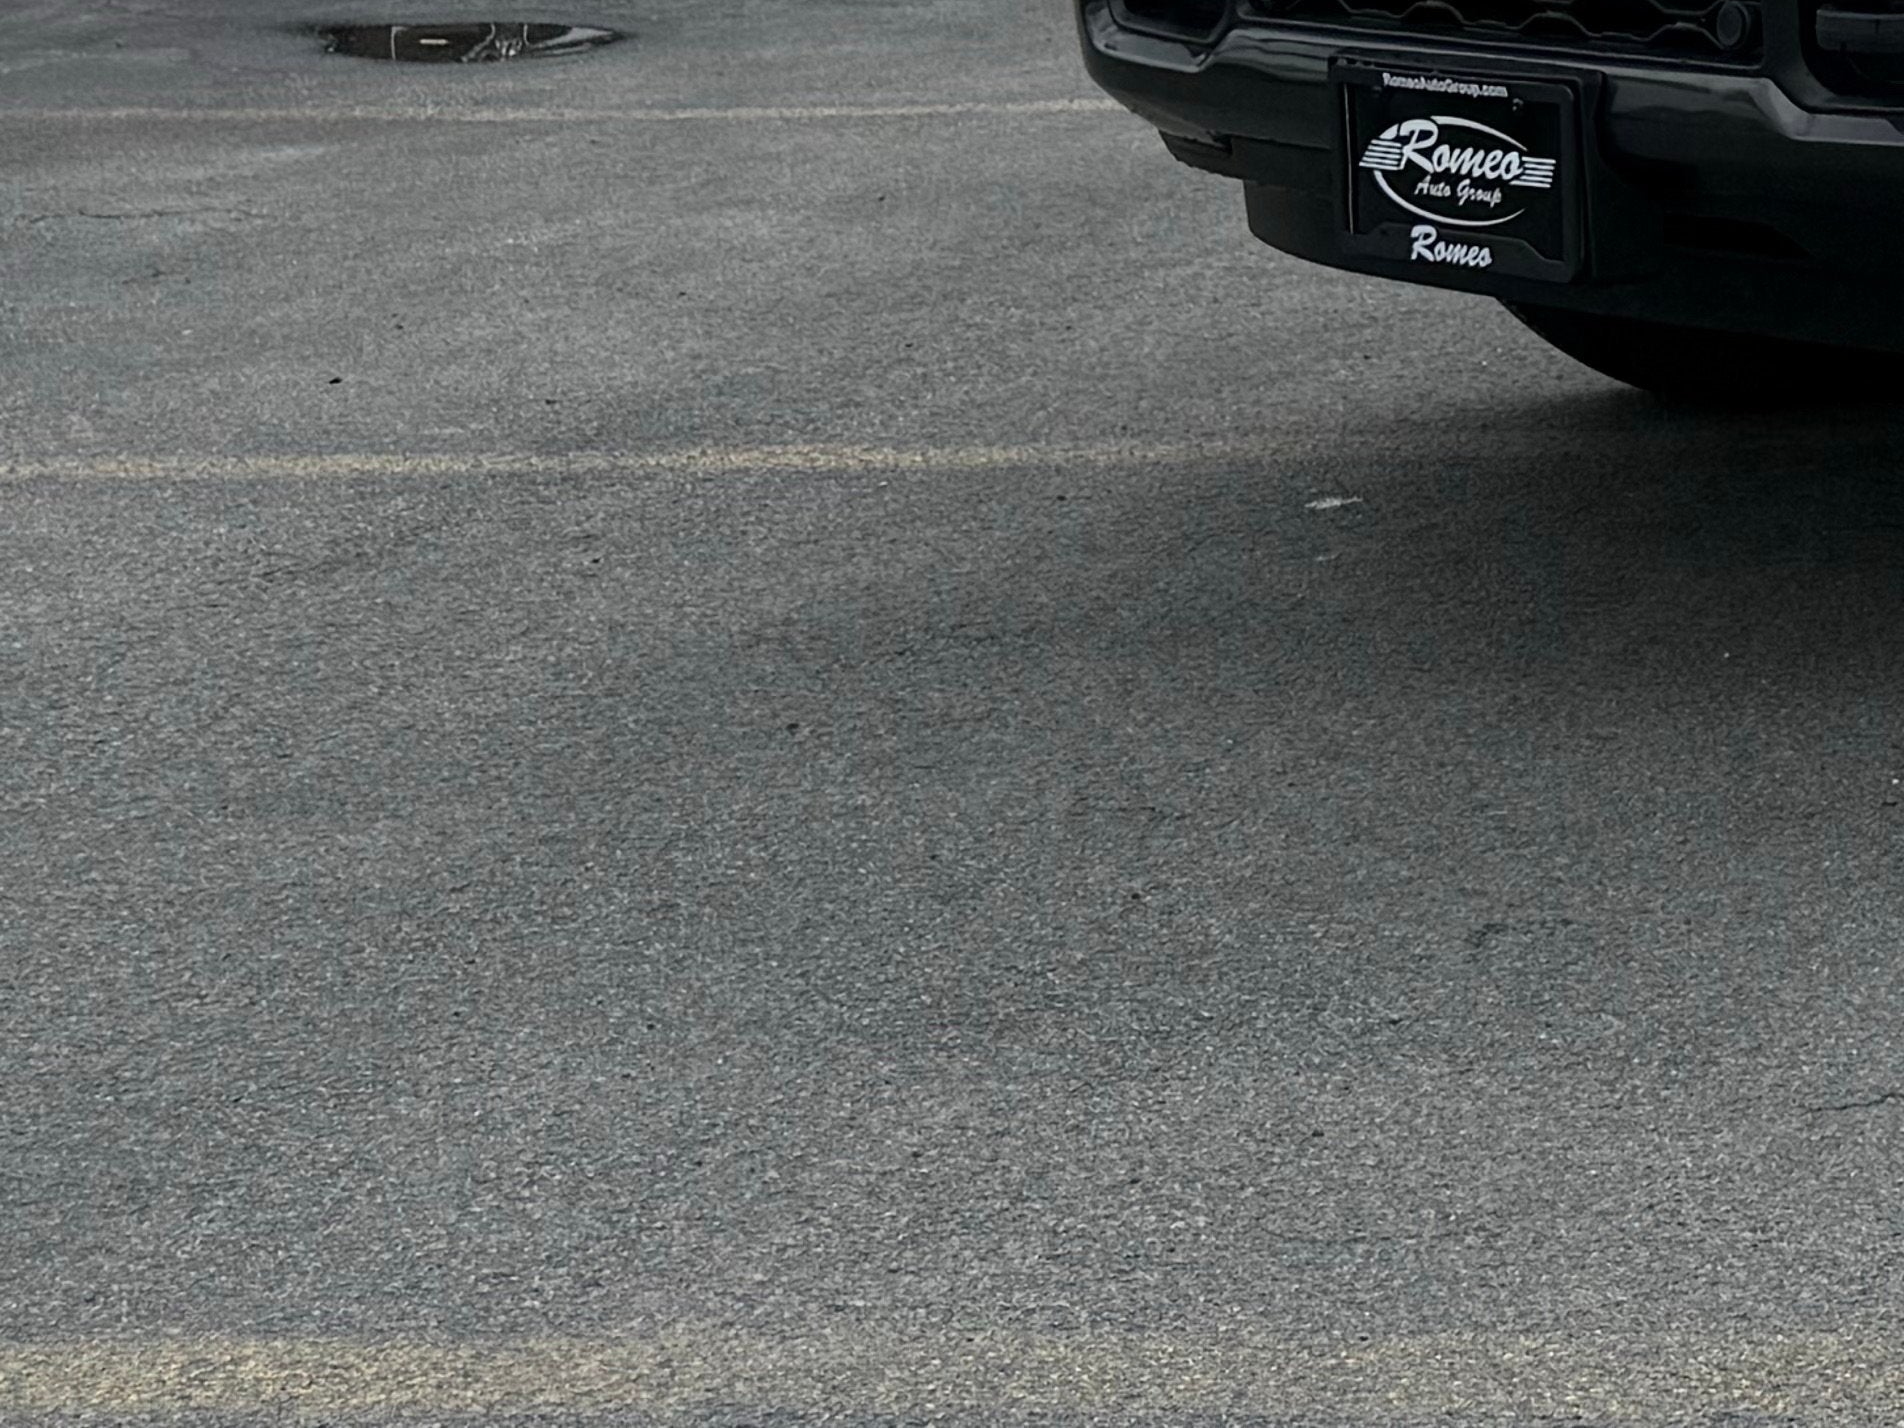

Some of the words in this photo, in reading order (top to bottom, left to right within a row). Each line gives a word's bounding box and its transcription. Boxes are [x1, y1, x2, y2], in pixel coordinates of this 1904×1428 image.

[1399, 118, 1524, 180] Romeo
[1414, 174, 1450, 196] Auto
[1456, 178, 1502, 208] Group
[1410, 224, 1492, 268] Romeo
